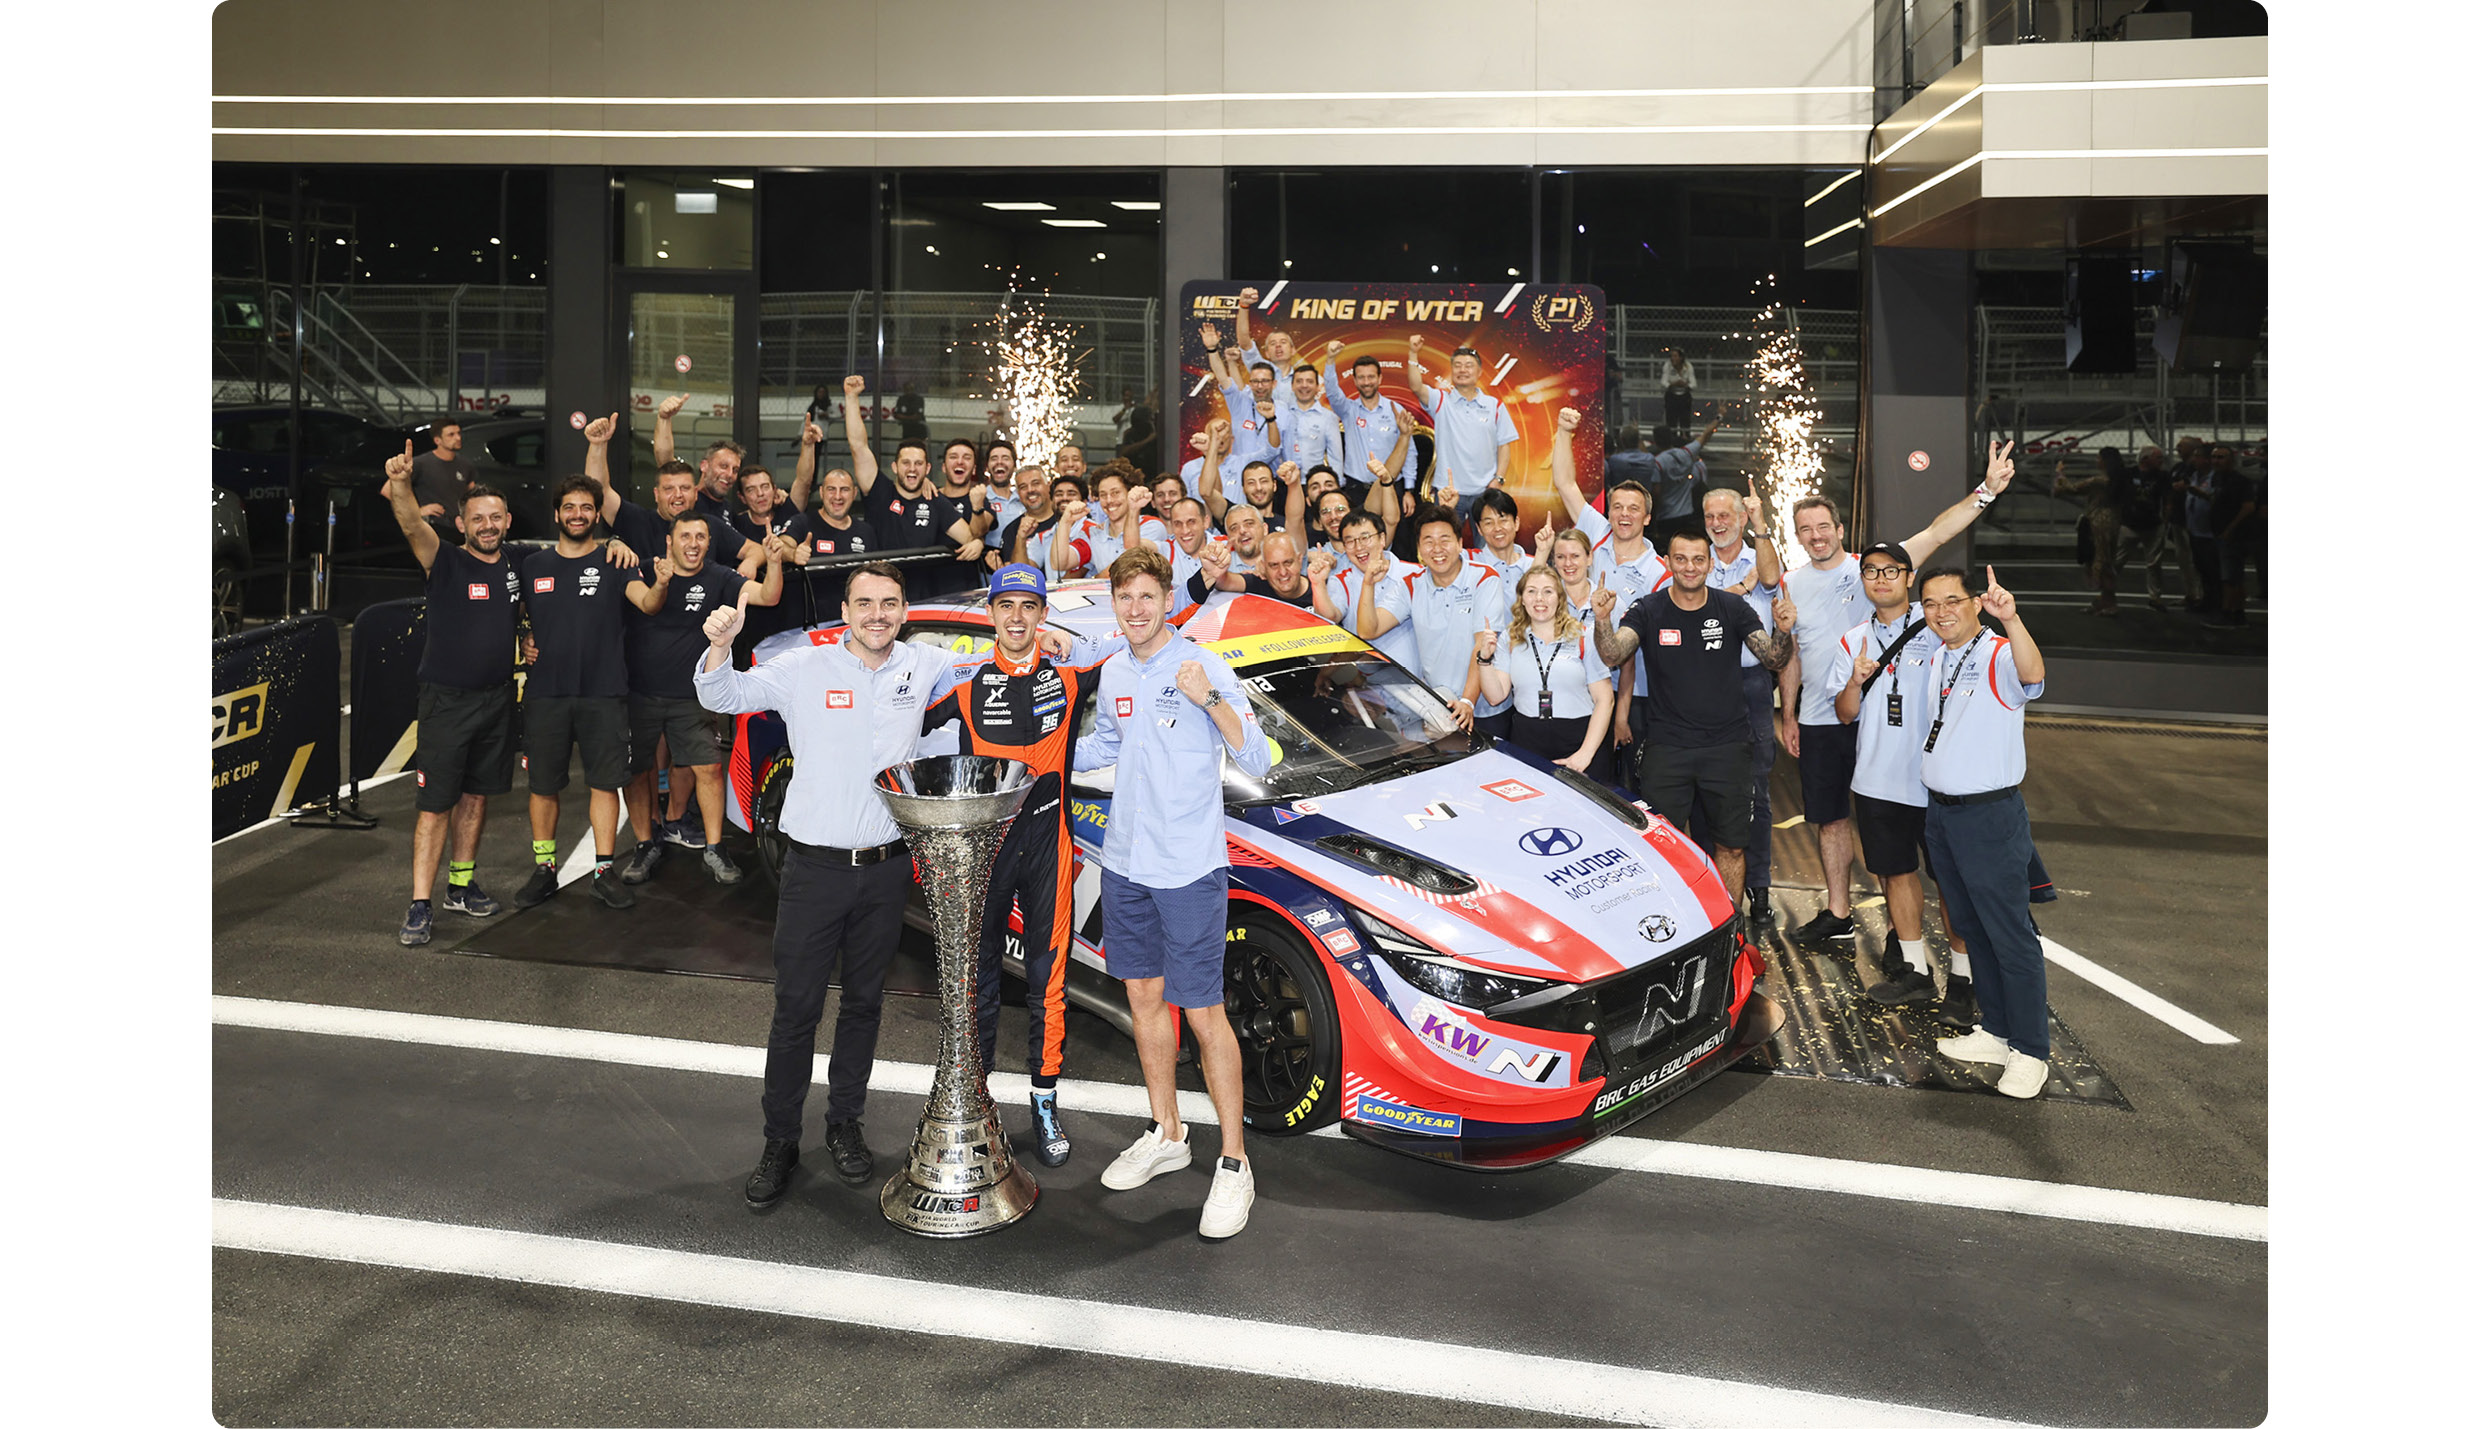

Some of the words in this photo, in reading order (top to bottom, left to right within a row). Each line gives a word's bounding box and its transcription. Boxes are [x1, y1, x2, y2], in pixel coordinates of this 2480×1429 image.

[1290, 298, 1356, 320] KING
[1361, 300, 1399, 320] OF
[1406, 300, 1484, 322] WTCR
[1548, 298, 1578, 318] P1
[1222, 649, 1245, 661] AR
[1259, 633, 1350, 653] #FOLLOWTHELEADER
[233, 760, 259, 781] CUP
[1544, 847, 1632, 887] HYUNDAI
[1565, 862, 1646, 901] MOTORSPORT
[1591, 892, 1632, 914] Customer
[1630, 882, 1661, 899] Racing
[1307, 911, 1331, 925] OMP
[1421, 1013, 1492, 1058] KW
[1594, 1085, 1627, 1112] BRC
[1628, 1069, 1659, 1096] GAS
[1659, 1027, 1728, 1079] EQUIPMENT
[1284, 1074, 1326, 1127] EAGLE
[1363, 1103, 1455, 1128] GOODYEAR
